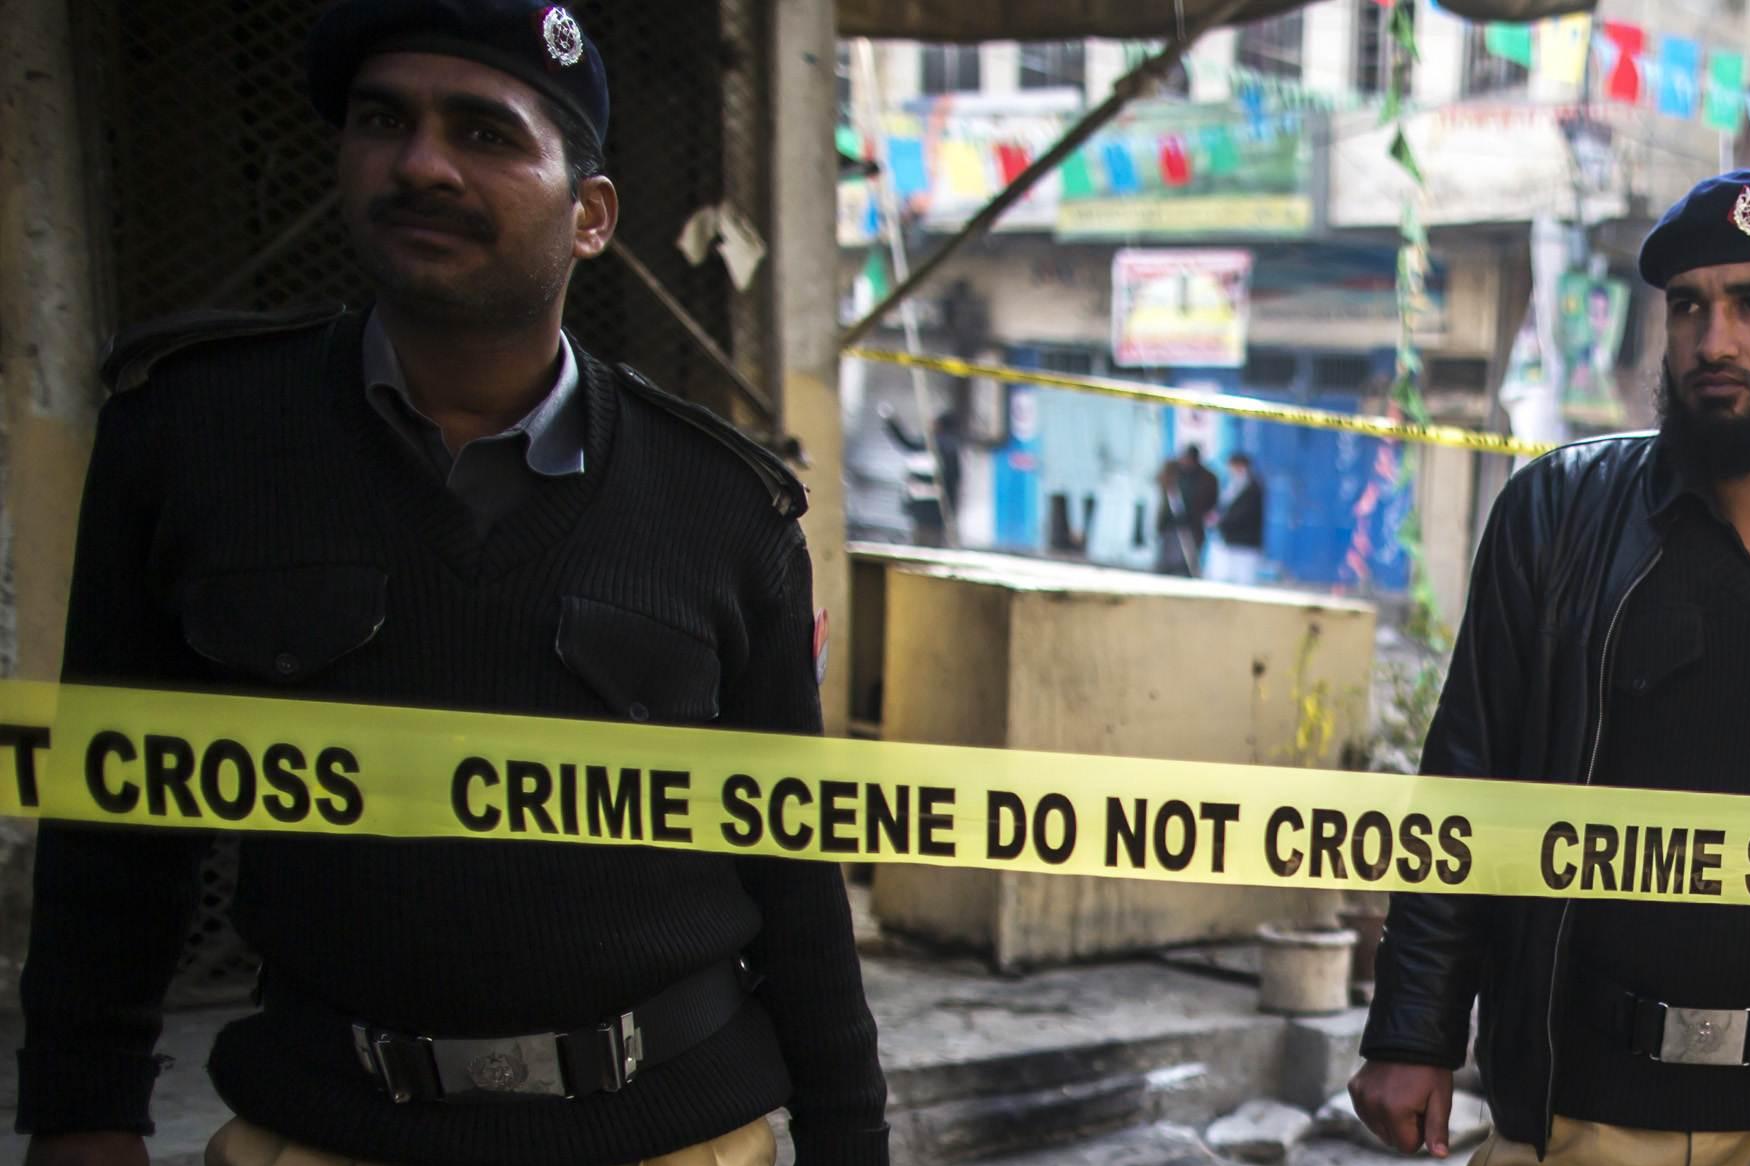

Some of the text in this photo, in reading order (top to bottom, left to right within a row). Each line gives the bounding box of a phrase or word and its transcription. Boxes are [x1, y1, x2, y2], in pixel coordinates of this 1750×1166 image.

[85, 730, 363, 825] CROSS
[451, 756, 693, 843] CRIME
[720, 774, 956, 858] SCENE
[987, 790, 1076, 864] DO
[1105, 797, 1240, 872] NOT
[1265, 806, 1472, 885] CROSS
[1541, 821, 1725, 895] CRIME
